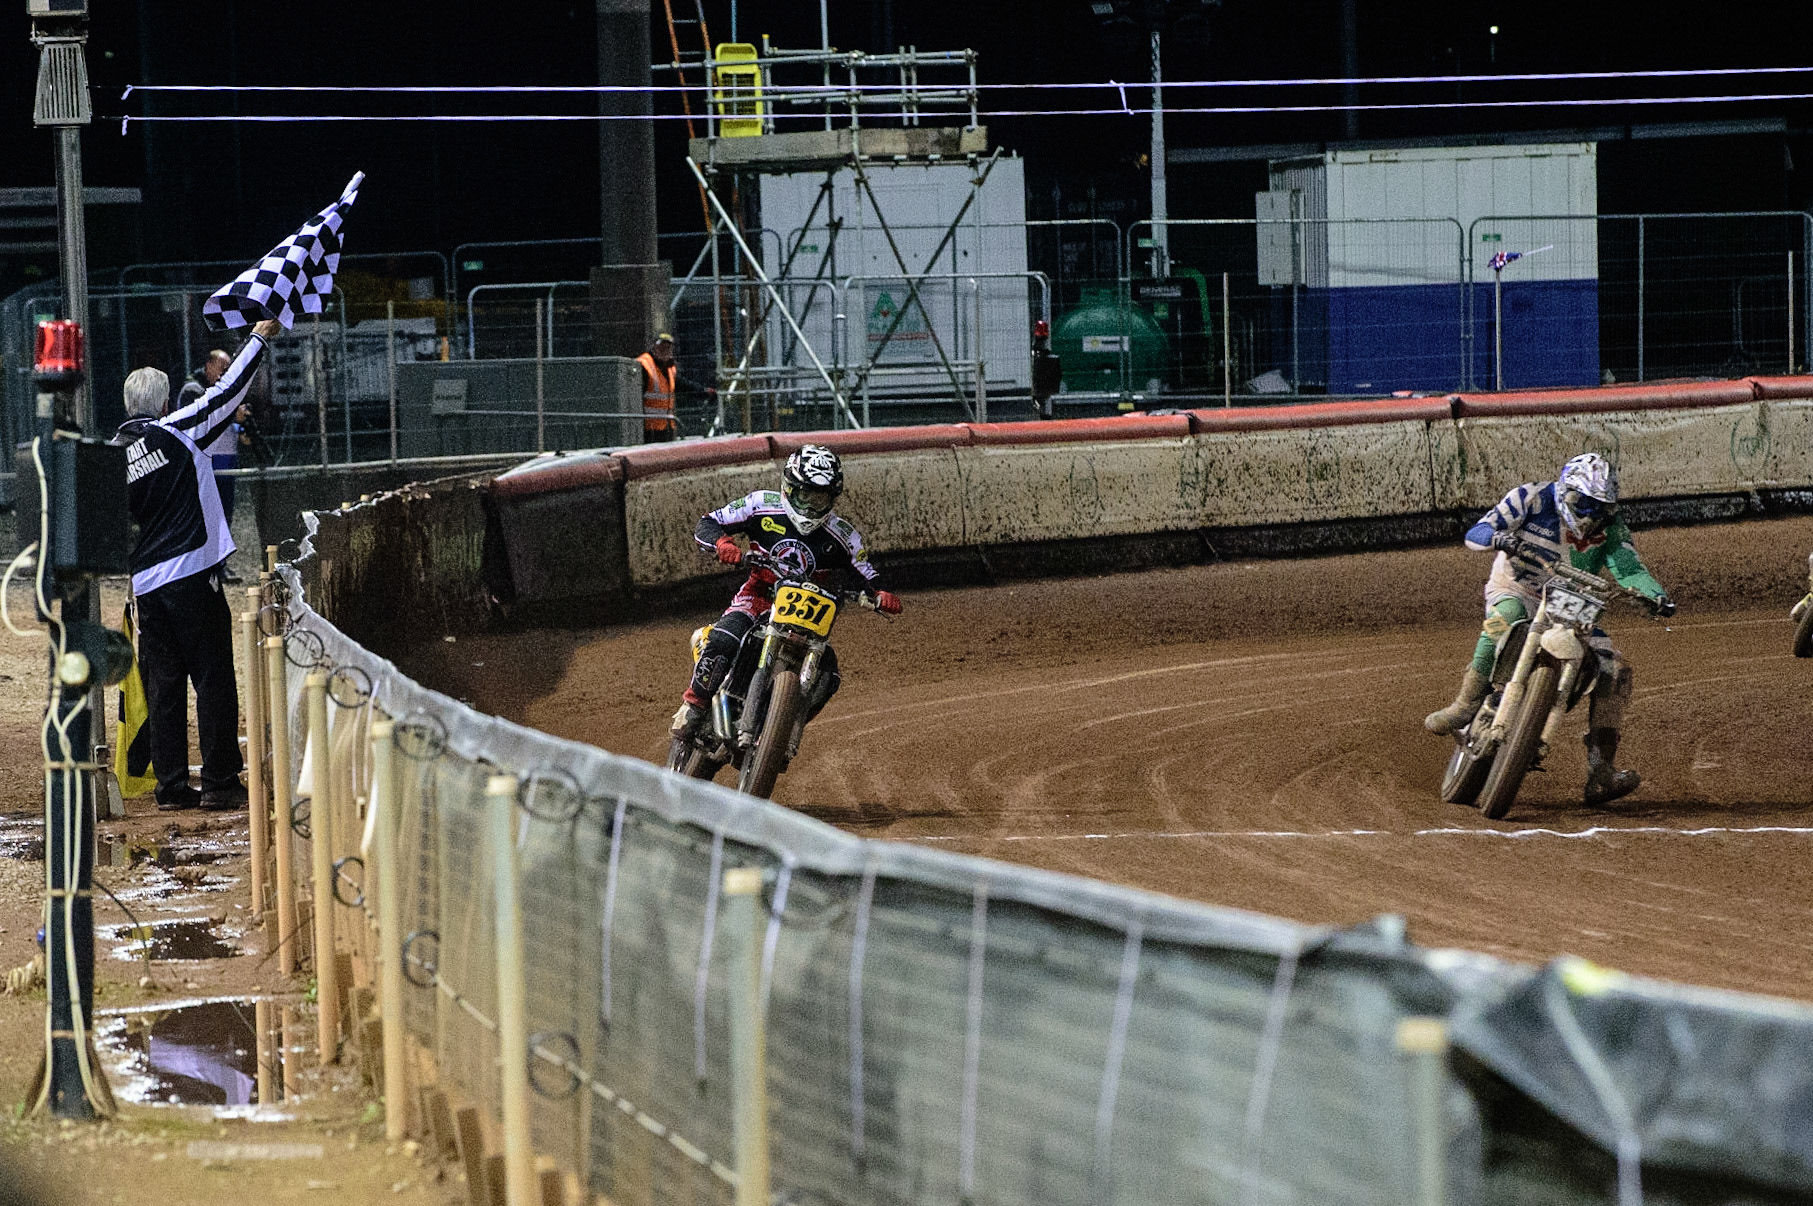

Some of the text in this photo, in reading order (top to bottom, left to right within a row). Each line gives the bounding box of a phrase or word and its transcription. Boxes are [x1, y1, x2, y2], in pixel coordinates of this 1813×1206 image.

[126, 436, 149, 464] TART
[126, 448, 170, 485] ARSHALL
[778, 592, 831, 626] 351
